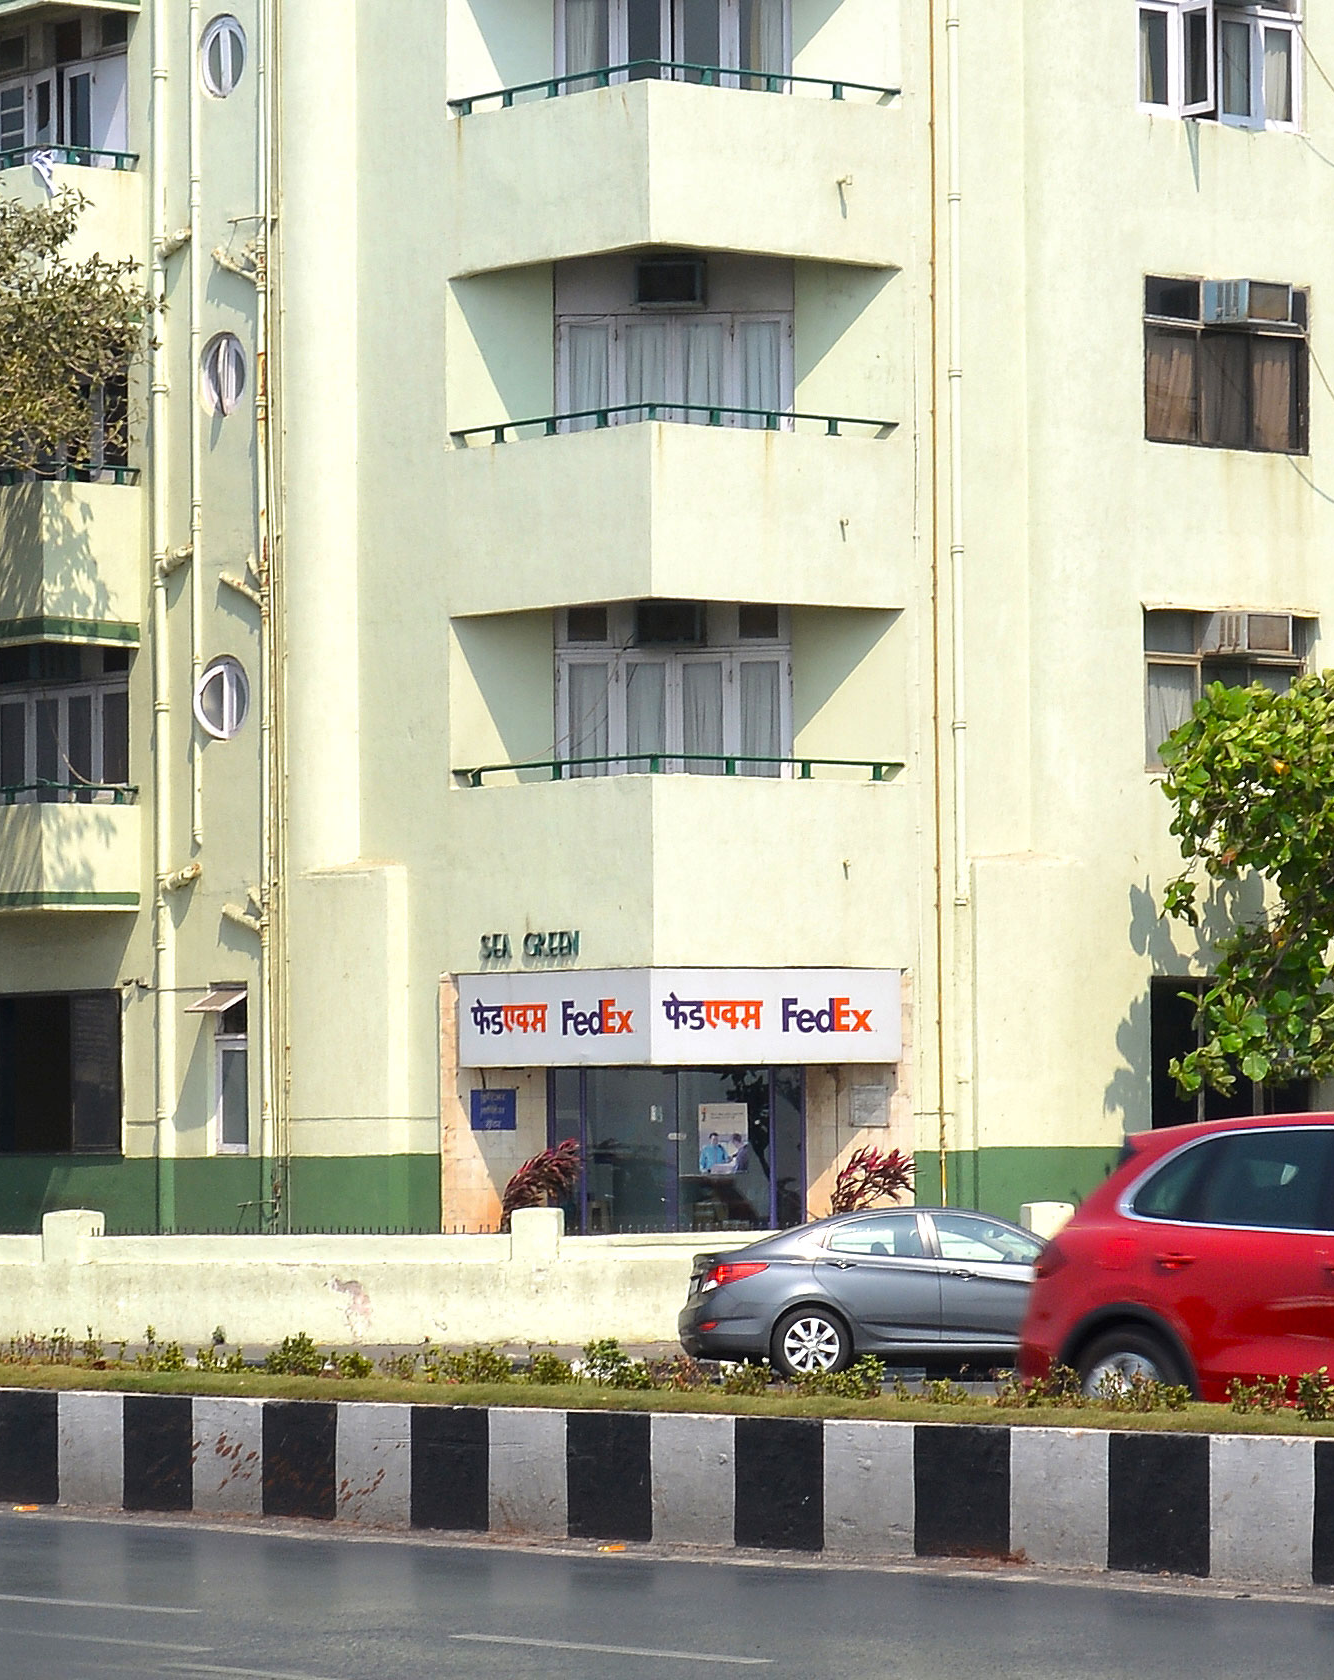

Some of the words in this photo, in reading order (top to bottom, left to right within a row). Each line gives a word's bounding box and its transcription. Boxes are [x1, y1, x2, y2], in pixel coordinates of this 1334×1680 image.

[480, 934, 513, 959] SEA
[524, 930, 580, 956] GREEN
[470, 998, 548, 1035] फेडएक्स
[561, 998, 634, 1036] FedEx
[662, 991, 763, 1030] फेडएक्स
[781, 997, 873, 1033] FedEx
